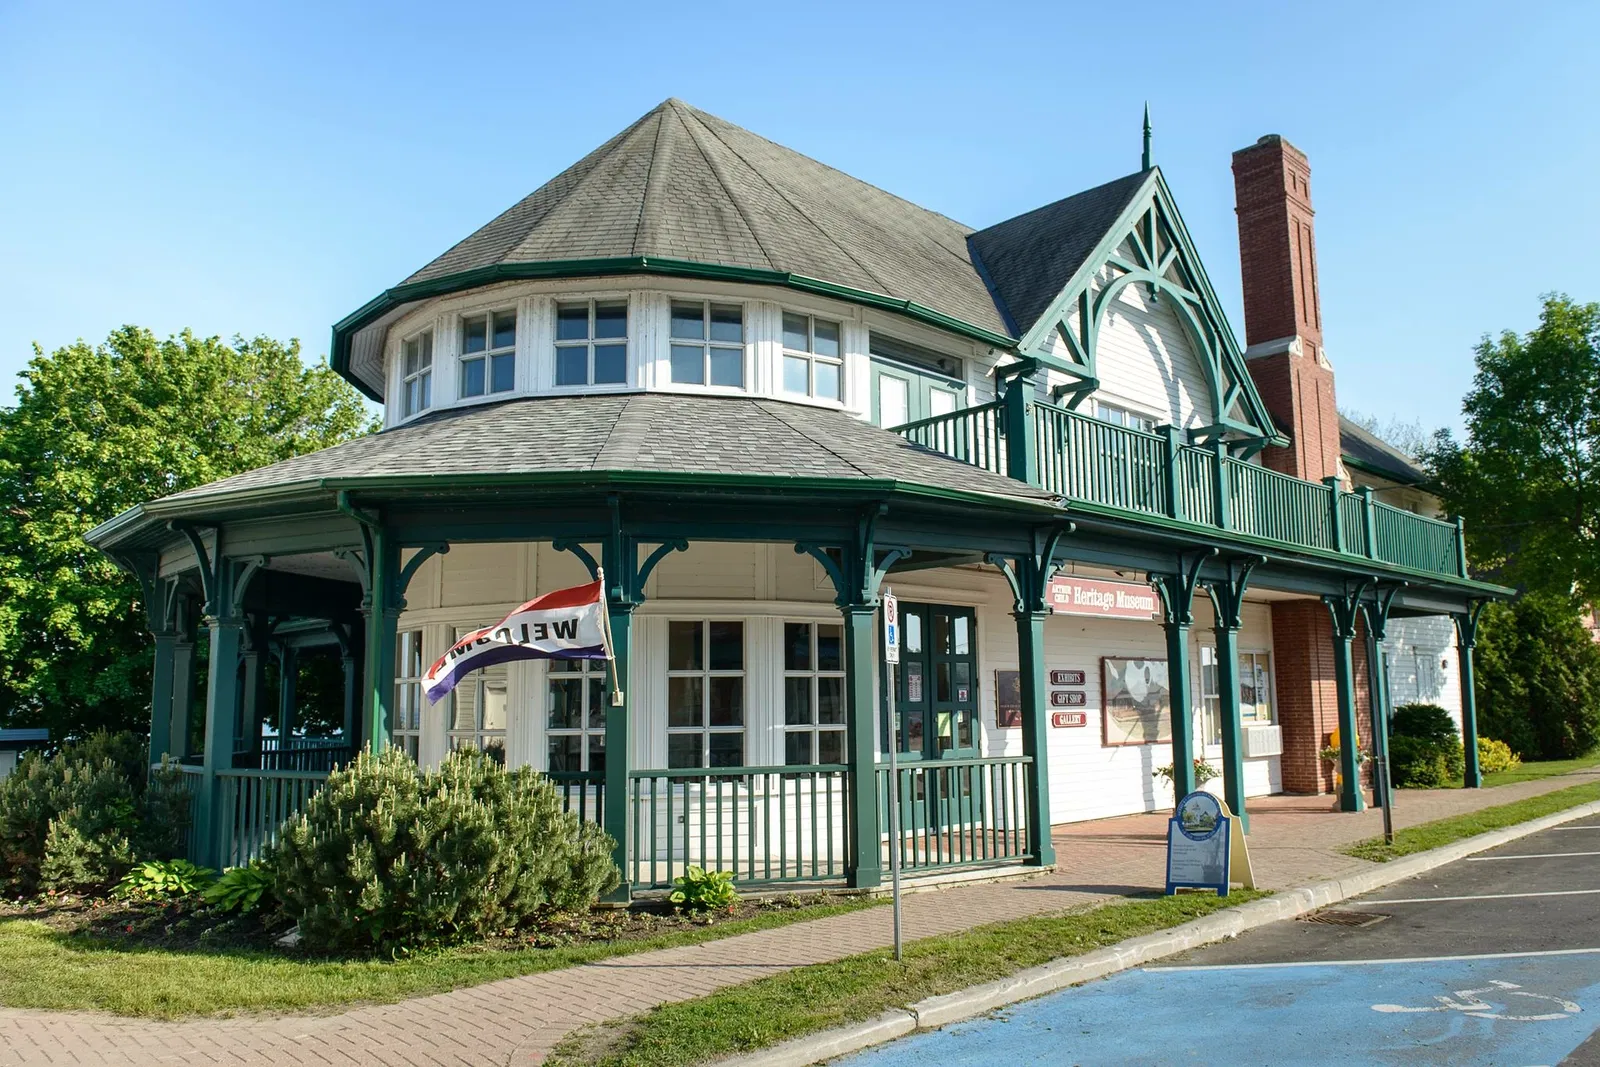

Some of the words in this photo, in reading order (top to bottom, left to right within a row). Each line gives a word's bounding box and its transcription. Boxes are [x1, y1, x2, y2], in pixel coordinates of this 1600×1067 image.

[1074, 586, 1115, 611] Heritage
[1116, 590, 1154, 610] Museum
[1057, 673, 1081, 683] EXHIBITS
[1057, 694, 1069, 704] GIFT
[1069, 694, 1082, 704] SHOP
[1059, 714, 1082, 725] GALLERY
